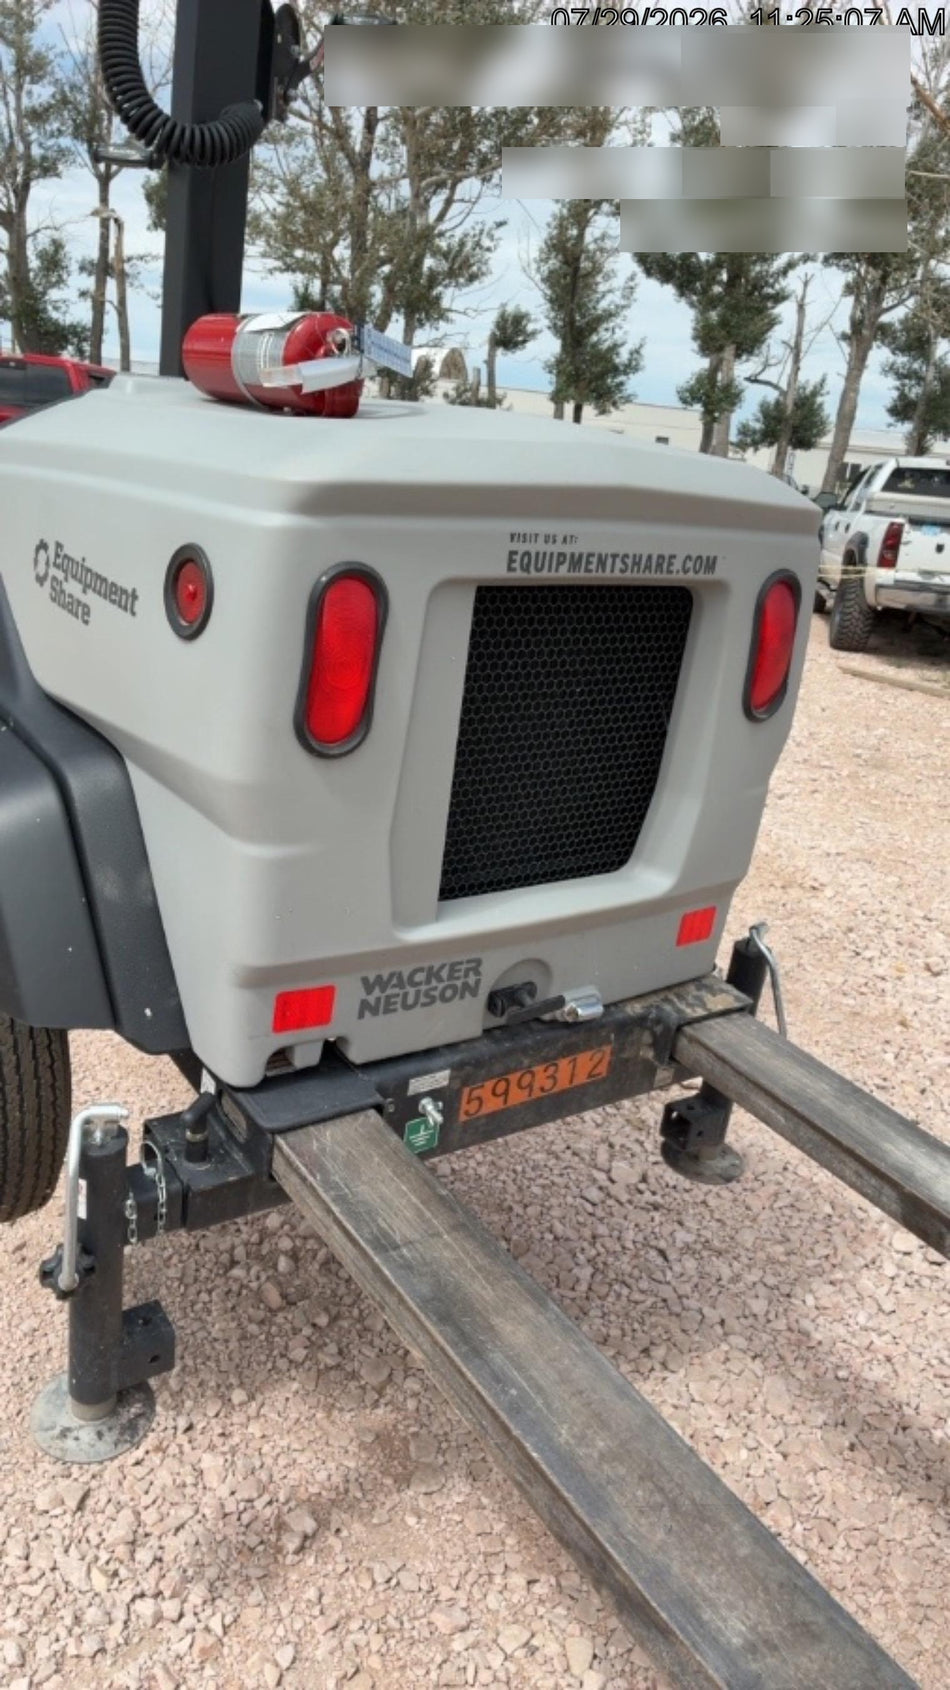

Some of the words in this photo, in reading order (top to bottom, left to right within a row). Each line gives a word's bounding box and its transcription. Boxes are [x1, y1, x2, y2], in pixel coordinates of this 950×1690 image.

[509, 532, 539, 544] VISIT
[544, 533, 558, 545] US
[562, 534, 579, 545] AT:
[52, 540, 139, 617] Equipment
[506, 550, 718, 575] EQUIPMENTSHARE.COM
[49, 574, 91, 626] Share
[360, 957, 483, 996] WACKER
[357, 978, 482, 1020] NEUSON
[462, 1049, 606, 1117] 599312
